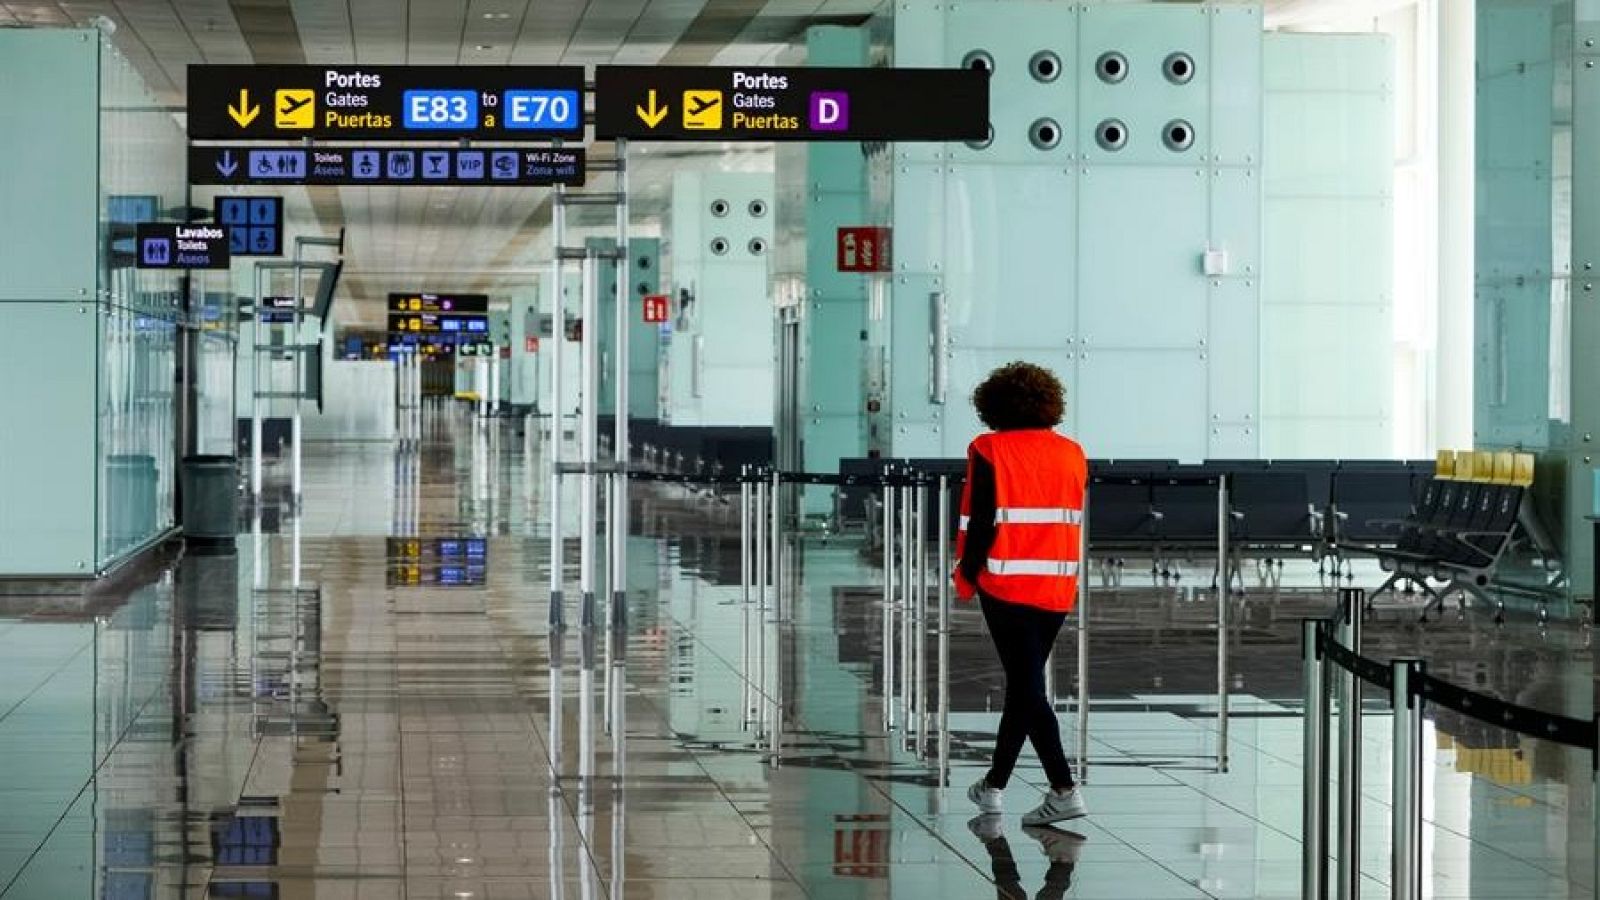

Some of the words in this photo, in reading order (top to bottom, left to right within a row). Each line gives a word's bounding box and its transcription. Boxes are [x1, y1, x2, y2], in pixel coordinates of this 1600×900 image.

[325, 70, 381, 88] Portes
[732, 72, 788, 90] Portes
[326, 91, 368, 107] Gates
[482, 92, 498, 107] to
[733, 92, 775, 108] Gates
[411, 96, 468, 122] E83
[511, 97, 569, 122] E70
[818, 98, 840, 124] D
[326, 111, 392, 128] Puertas
[484, 114, 495, 127] a
[733, 113, 799, 129] Puertas
[314, 152, 343, 163] Toilets
[460, 159, 481, 171] VIP
[526, 152, 550, 163] Wi-Fi
[552, 152, 576, 163] Zone
[175, 226, 223, 239] Lavabos
[177, 239, 208, 250] Toilets
[177, 253, 210, 264] Aseos
